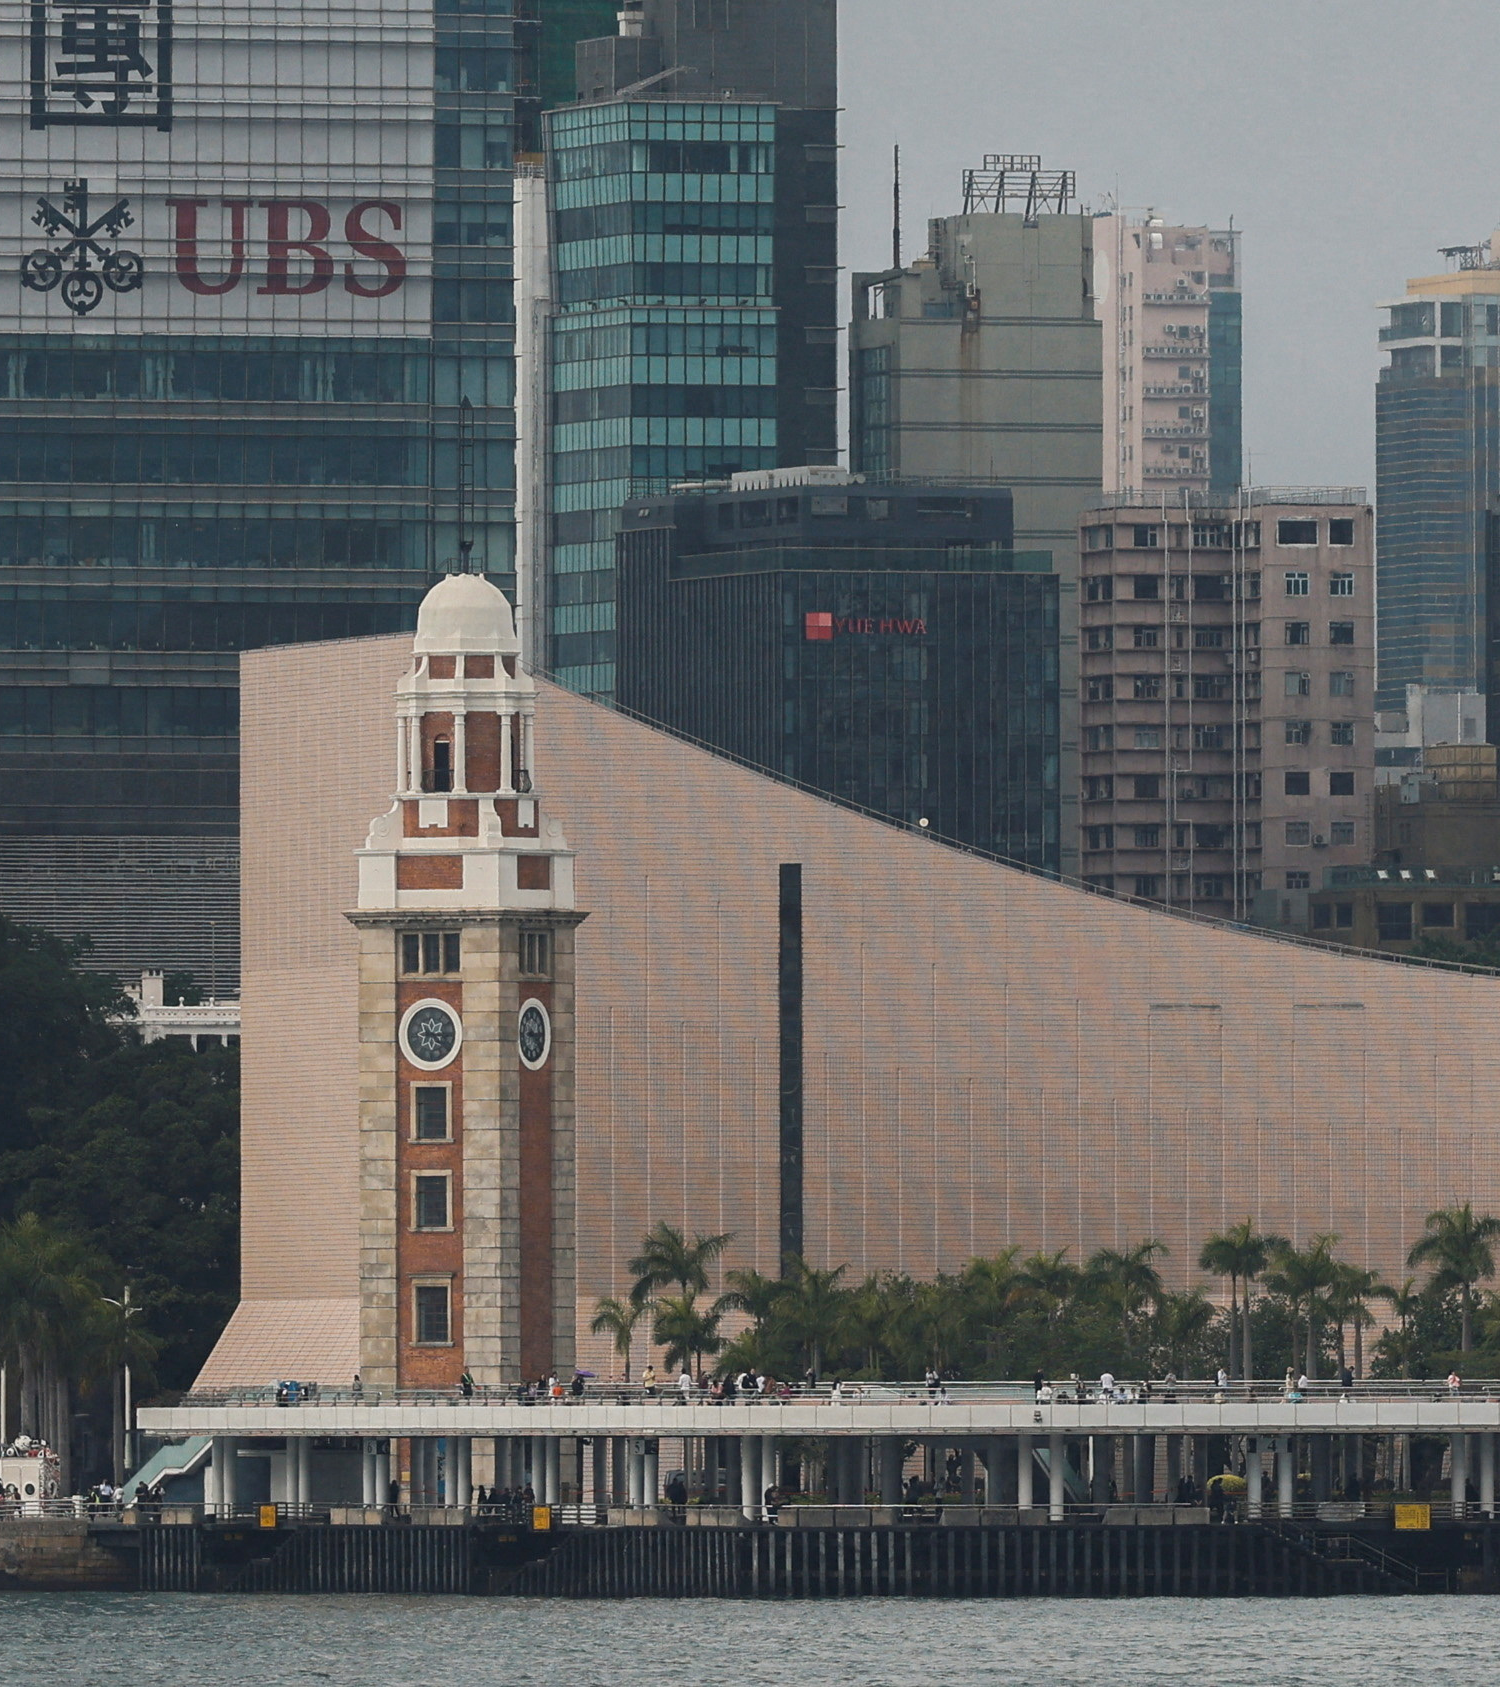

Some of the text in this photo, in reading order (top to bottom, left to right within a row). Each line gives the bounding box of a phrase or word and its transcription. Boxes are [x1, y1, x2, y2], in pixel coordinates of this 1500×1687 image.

[166, 198, 408, 299] UBS
[833, 618, 928, 634] YUE HWA
[1267, 1439, 1277, 1452] 4
